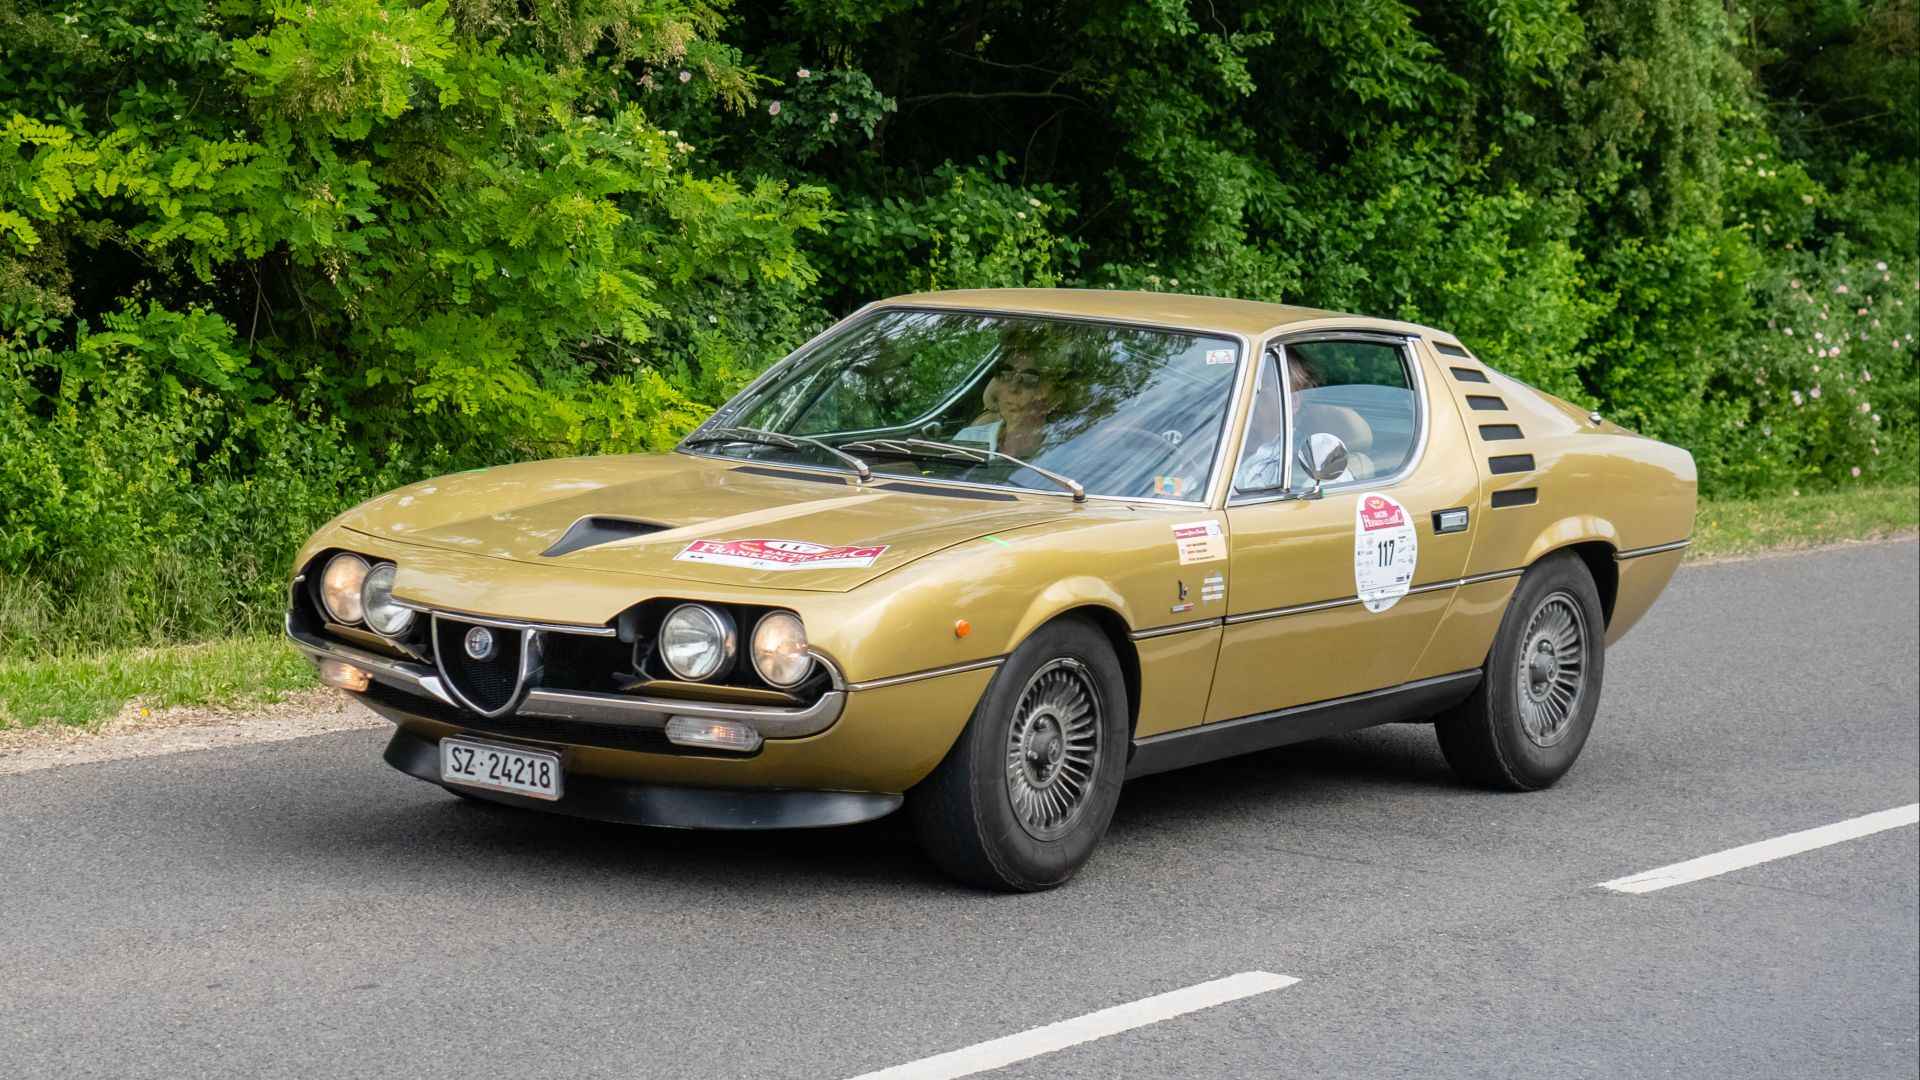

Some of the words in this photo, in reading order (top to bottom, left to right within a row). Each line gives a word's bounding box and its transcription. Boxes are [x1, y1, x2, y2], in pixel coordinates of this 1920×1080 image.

[697, 542, 785, 563] FRANKEN
[785, 548, 877, 564] CLASSIC
[779, 543, 820, 552] 117
[1378, 539, 1395, 568] 117
